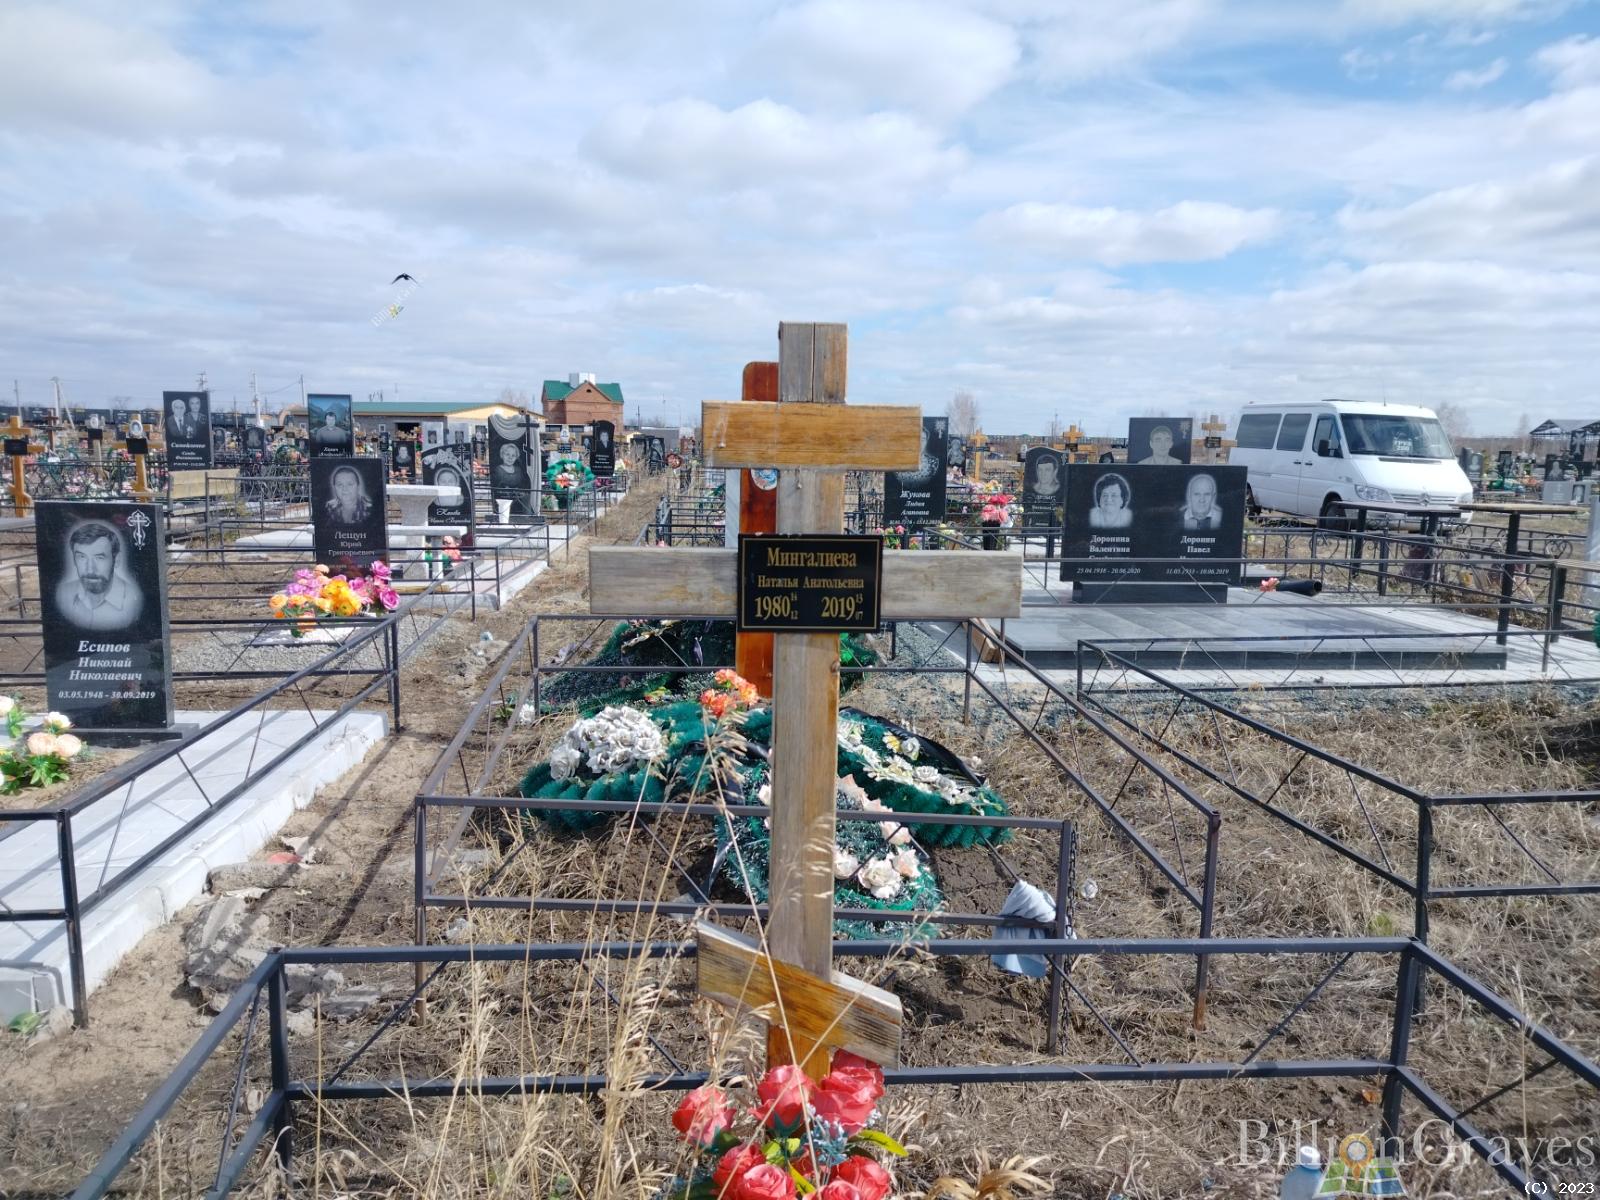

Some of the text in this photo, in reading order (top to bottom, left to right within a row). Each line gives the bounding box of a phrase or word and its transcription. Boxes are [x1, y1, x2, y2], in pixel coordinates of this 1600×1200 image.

[900, 490, 930, 499] Жукова
[334, 531, 367, 541] Лещун
[1090, 534, 1131, 544] Доронина
[1180, 535, 1217, 545] Доронин
[1089, 544, 1131, 553] Валентина
[1187, 545, 1211, 553] Павел
[767, 547, 857, 567] Мингалиева
[757, 575, 865, 589] Наталья Анатольевна
[754, 595, 791, 620] 1980
[821, 596, 856, 621] 2019
[78, 640, 130, 652] Есипов
[78, 657, 131, 667] Николай
[69, 670, 141, 680] Николаевич
[58, 691, 104, 699] 03.05.1948
